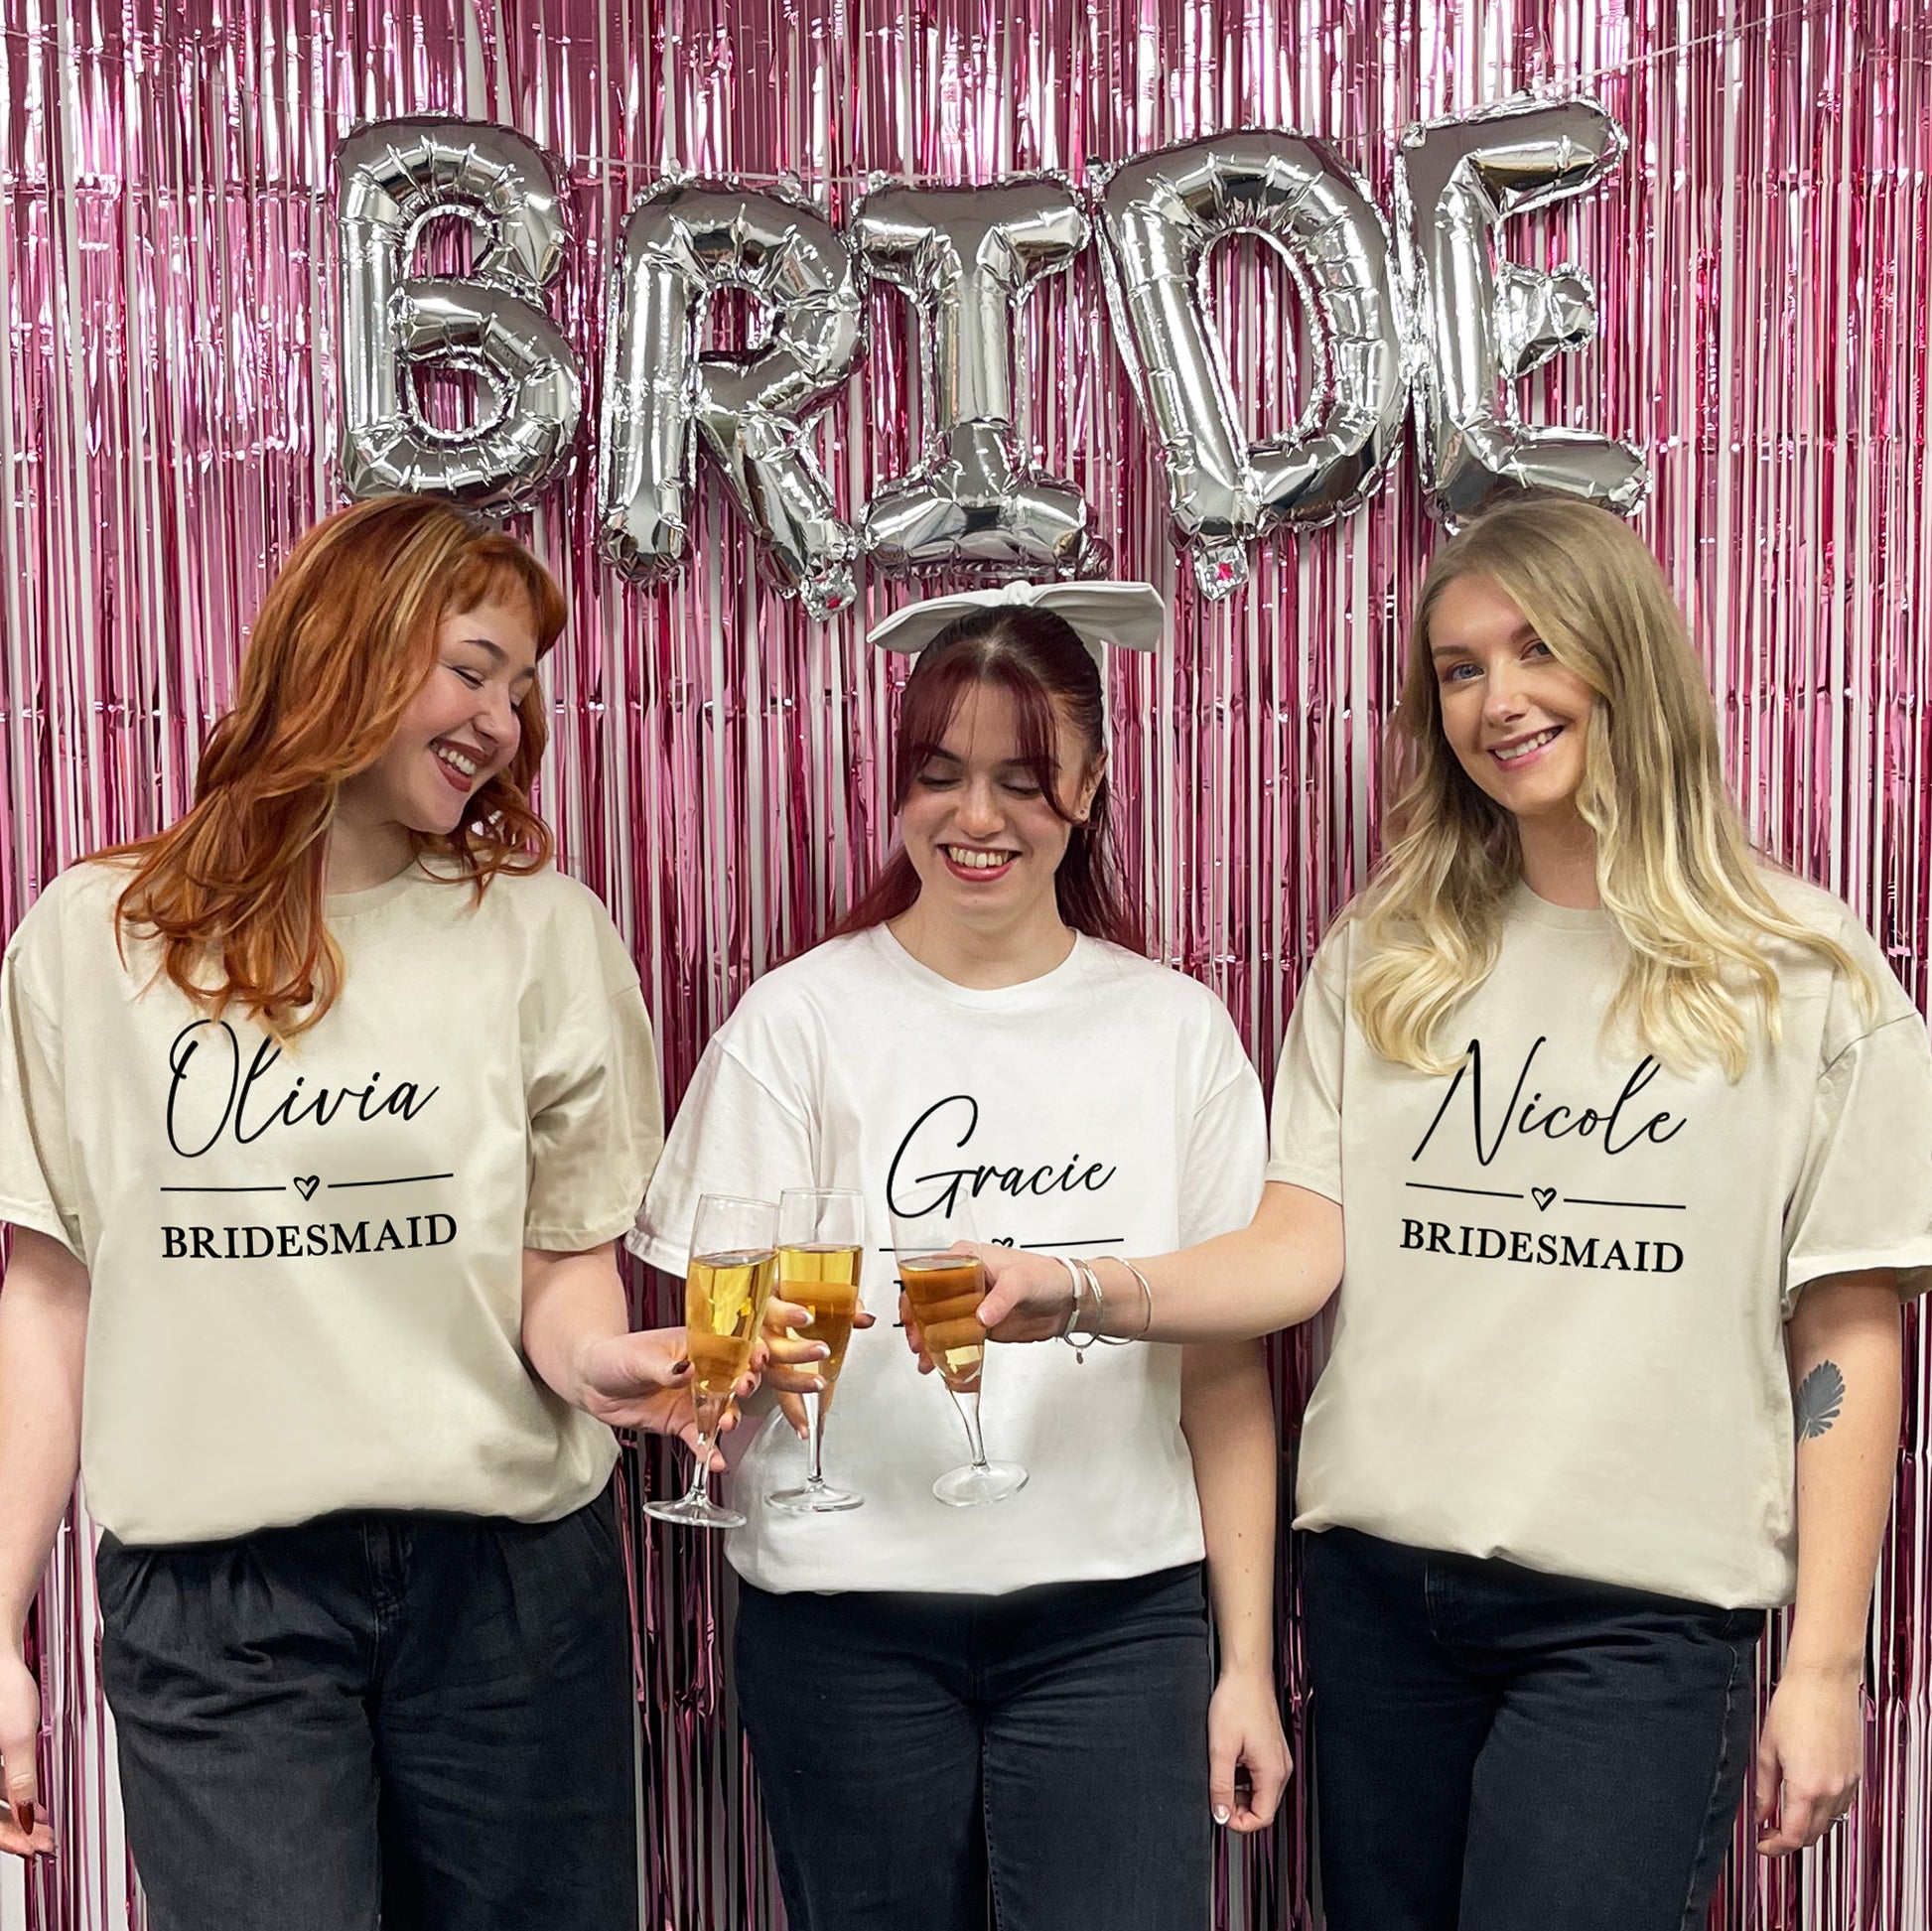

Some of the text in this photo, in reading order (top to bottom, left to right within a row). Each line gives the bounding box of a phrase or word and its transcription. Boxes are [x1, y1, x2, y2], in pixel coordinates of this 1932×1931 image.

[335, 96, 1652, 606] BRIDE
[166, 1019, 440, 1159] Olivia
[1411, 1035, 1688, 1167] Nicole
[886, 1095, 1117, 1219] Gracie
[161, 1213, 458, 1259] BRIDESMAID
[1399, 1218, 1685, 1274] BRIDESMAID
